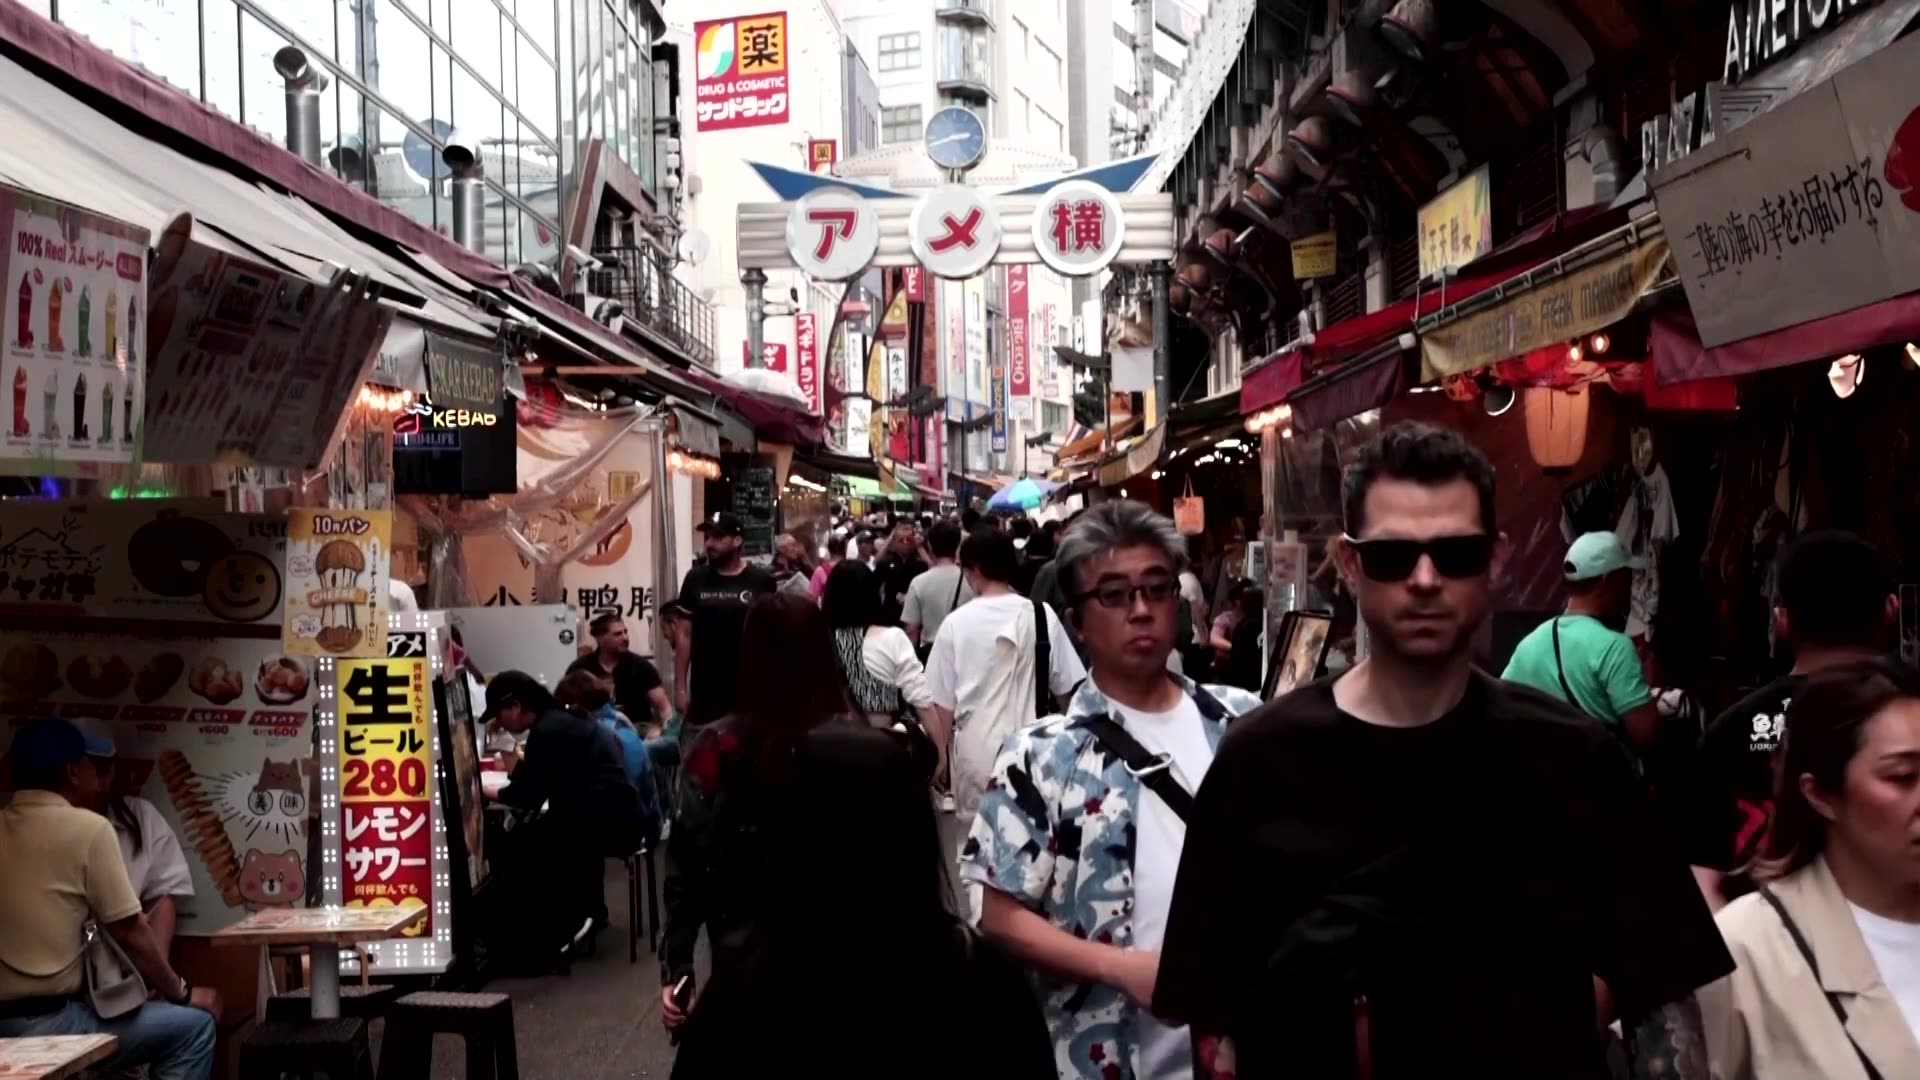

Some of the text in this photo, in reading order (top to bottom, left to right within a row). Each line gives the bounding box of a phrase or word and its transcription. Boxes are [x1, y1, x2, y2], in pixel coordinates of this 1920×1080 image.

[741, 23, 779, 69] 薬
[697, 76, 786, 97] DRUG & COSMETIC
[696, 93, 788, 122] サンドラッグ
[17, 231, 43, 258] 100%
[44, 239, 67, 263] Real
[68, 245, 114, 270] スムージー
[806, 200, 1105, 264] アメ横
[1011, 318, 1025, 385] BIG ECHO
[387, 634, 424, 657] アメ
[343, 665, 412, 726] 生
[344, 728, 425, 756] ビール
[342, 757, 426, 797] 280
[345, 806, 426, 842] レモン
[345, 847, 427, 882] サワー
